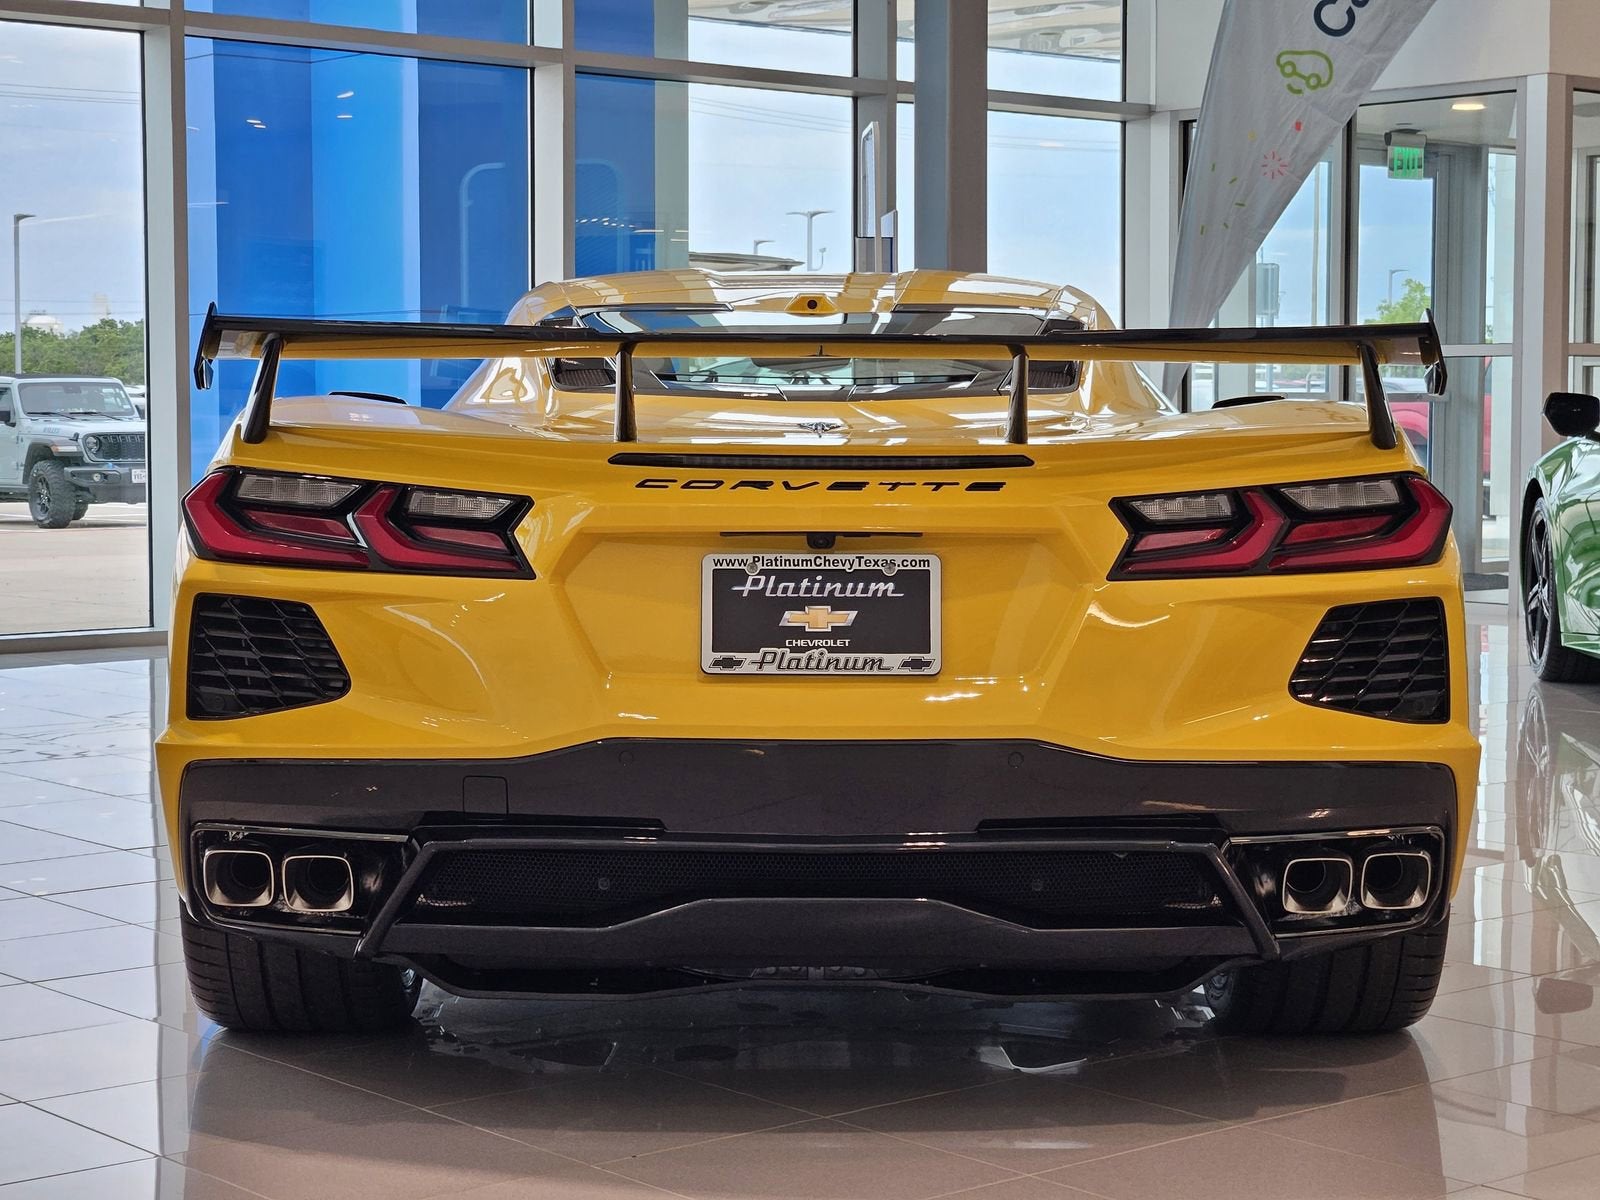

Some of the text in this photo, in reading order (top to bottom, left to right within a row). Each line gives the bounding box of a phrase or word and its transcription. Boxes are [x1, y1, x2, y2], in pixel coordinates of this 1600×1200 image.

[635, 478, 1007, 492] CORVETTE
[712, 555, 930, 569] wwwPlatinumChevyTexas.com
[731, 575, 904, 597] Platinum
[785, 639, 851, 647] CHEVROLET
[749, 650, 894, 671] Platinum
